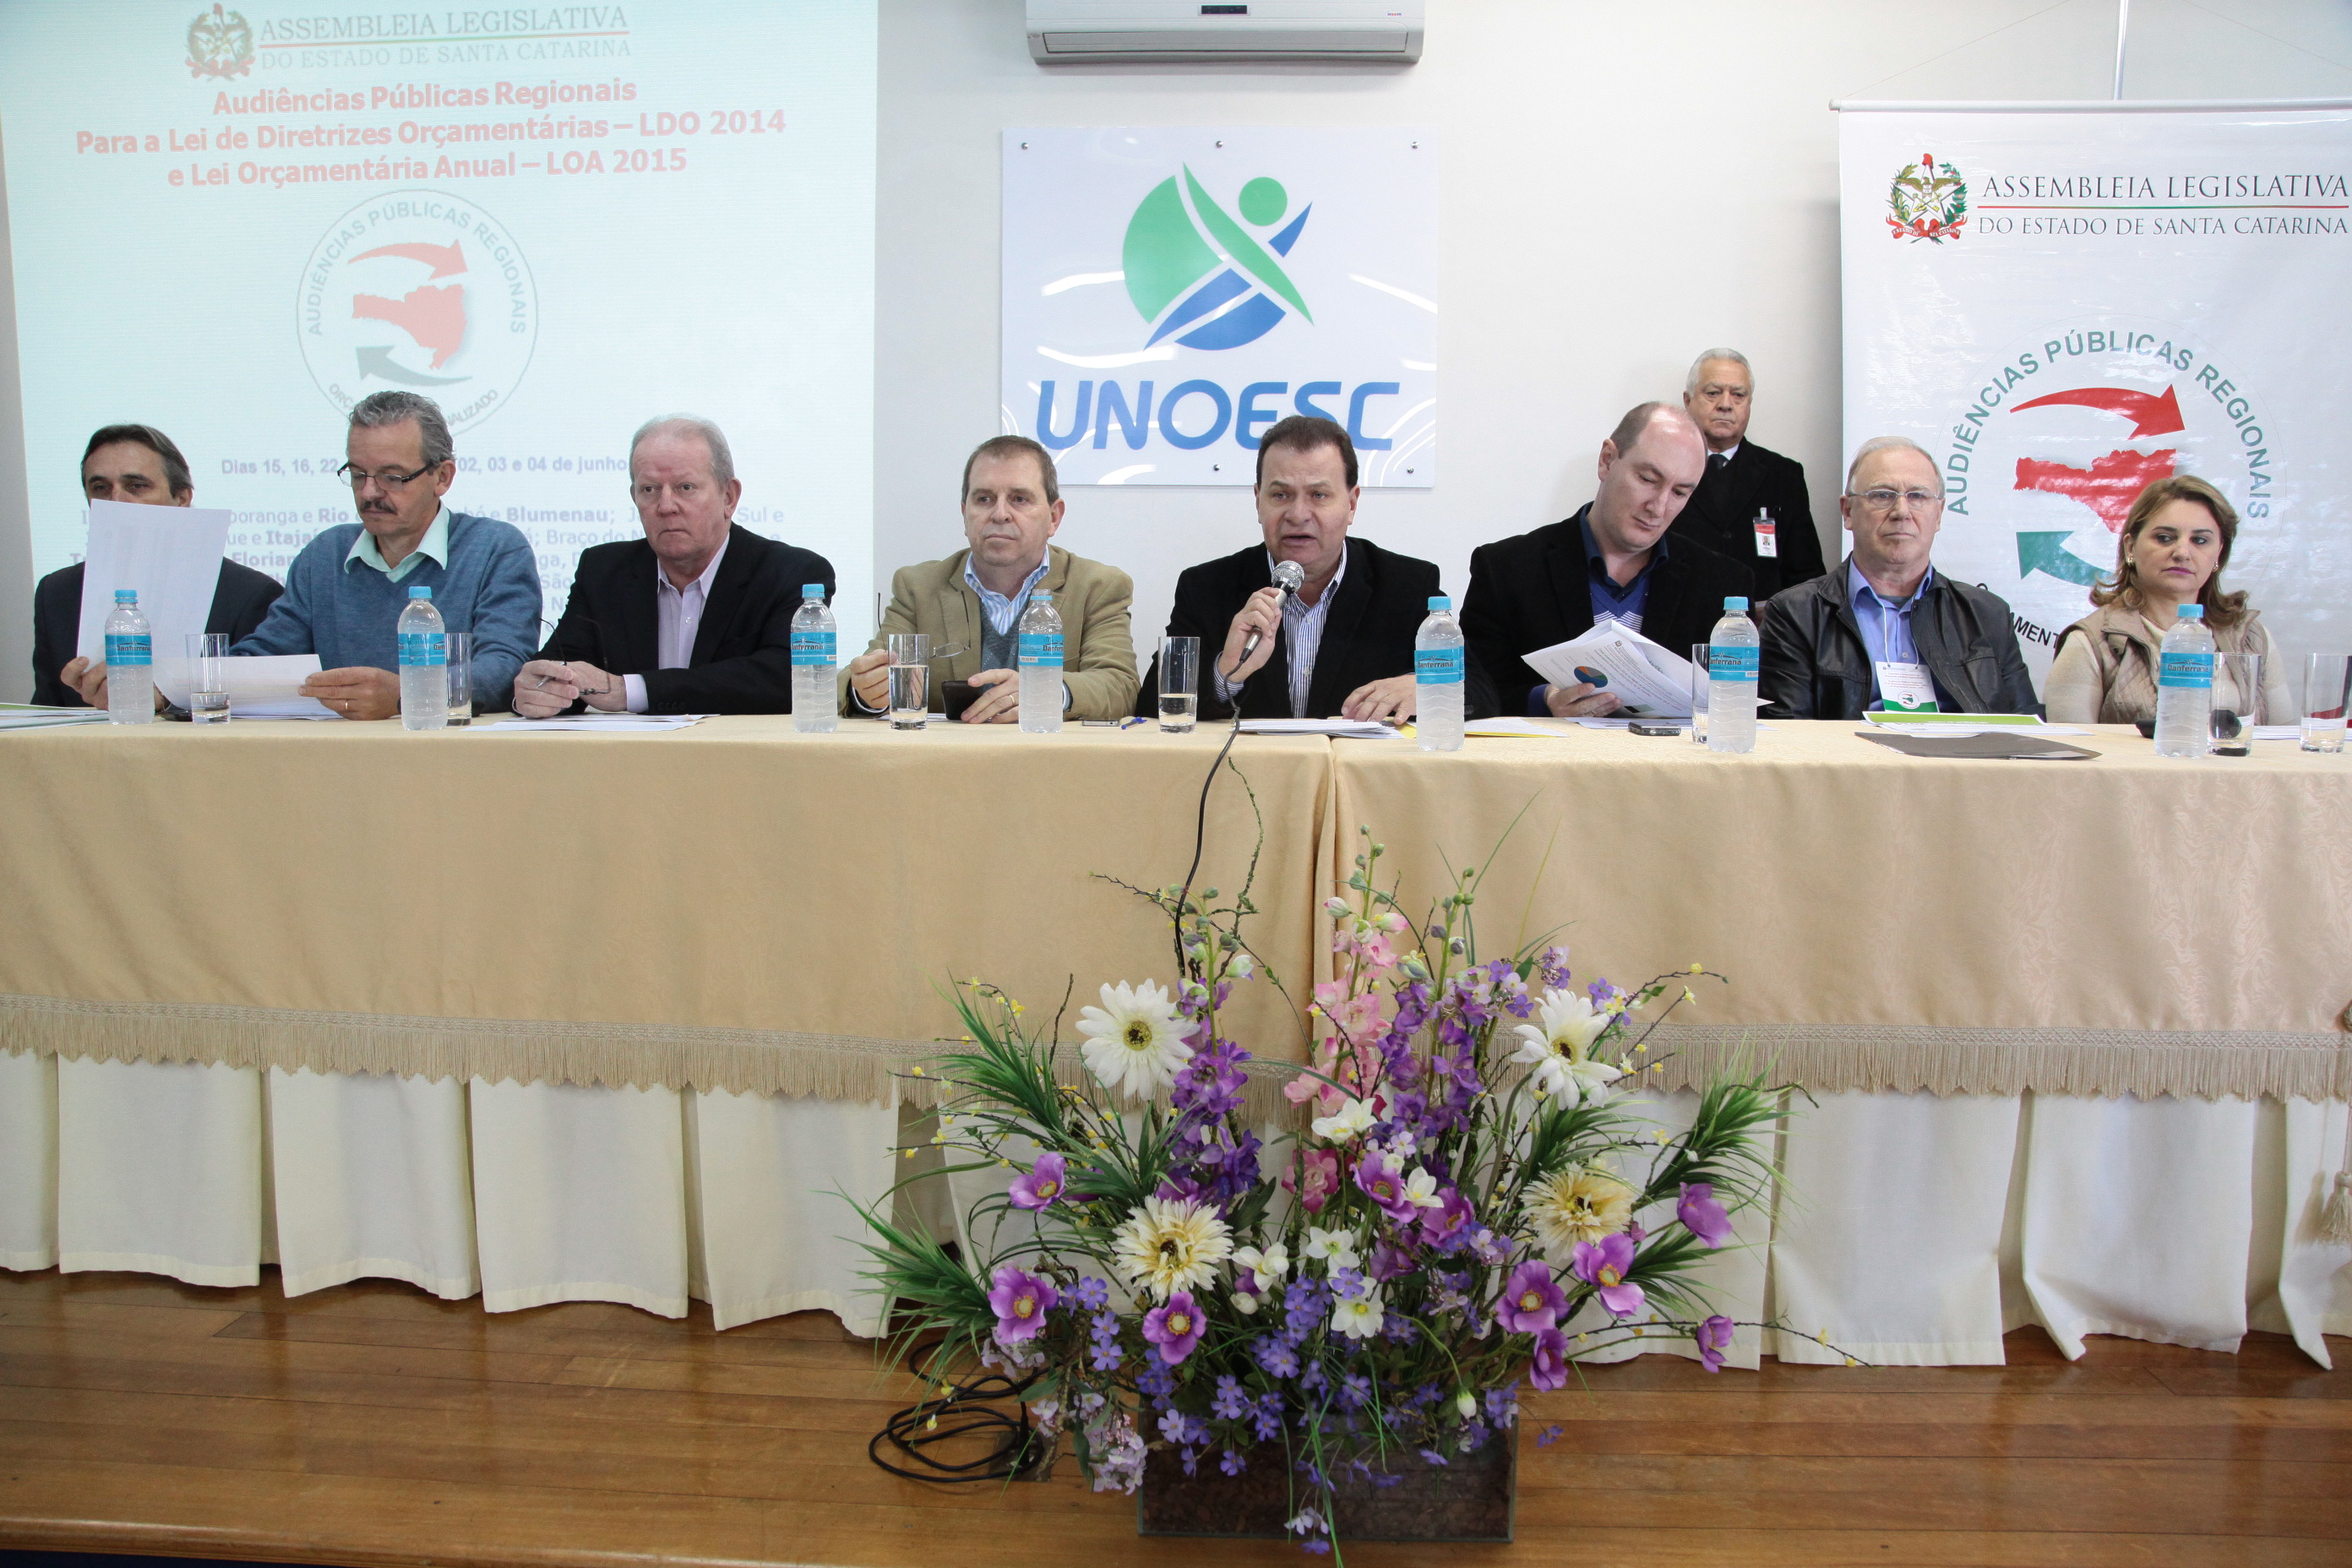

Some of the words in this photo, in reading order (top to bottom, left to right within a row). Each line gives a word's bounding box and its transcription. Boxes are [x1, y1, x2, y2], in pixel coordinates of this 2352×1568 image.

[260, 14, 437, 41] ASSEMBLEIA
[446, 6, 629, 34] LEGISLATIVA
[262, 51, 293, 69] DO
[301, 46, 395, 68] ESTADO
[400, 46, 431, 65] DE
[437, 43, 510, 64] SANTA
[516, 39, 632, 61] CATARINA
[213, 86, 365, 115] Audiências
[371, 82, 489, 110] Públicas
[494, 78, 637, 110] Regionais
[76, 131, 138, 155] Para
[144, 134, 160, 152] a
[168, 128, 208, 152] Lei
[215, 126, 248, 150] de
[258, 122, 392, 149] Diretrizes
[398, 113, 609, 149] Orçamentárias
[639, 111, 701, 137] LDO
[710, 109, 787, 135] 2014
[167, 167, 184, 187] e
[191, 161, 230, 187] Lei
[238, 155, 428, 189] Orçamentária
[434, 151, 516, 180] Anual
[547, 150, 606, 176] LOA
[613, 147, 688, 174] 2015
[1982, 175, 2156, 199] ASSEMBLEIA
[2167, 174, 2349, 199] LEGISLATIVA
[1979, 216, 2014, 235] DO
[2023, 216, 2108, 236] ESTADO
[2115, 217, 2145, 235] DE
[2153, 216, 2226, 235] SANTA
[2234, 216, 2349, 235] CATARINA
[307, 220, 366, 335] AUDIÊNCIAS
[368, 200, 471, 229] PÚBLICAS
[473, 221, 526, 335] REGIONAIS
[1036, 378, 1401, 451] UNOESC
[1946, 352, 2039, 517] AUDIÊNCIAS
[2044, 329, 2194, 372] PÚBLICAS
[2194, 362, 2273, 520] REGIONAIS
[221, 459, 258, 474] Dias
[263, 458, 286, 476] 15,
[292, 458, 314, 476] 16,
[459, 457, 482, 476] 02,
[487, 457, 508, 471] 03
[512, 460, 523, 472] e
[527, 456, 547, 471] 04
[553, 456, 574, 471] de
[577, 456, 627, 475] junho
[302, 511, 313, 523] e
[318, 507, 350, 523] Rio
[507, 507, 615, 525] Blumenau;
[736, 506, 767, 522] Sul
[772, 510, 784, 522] e
[251, 533, 262, 545] e
[546, 529, 598, 548] Braço
